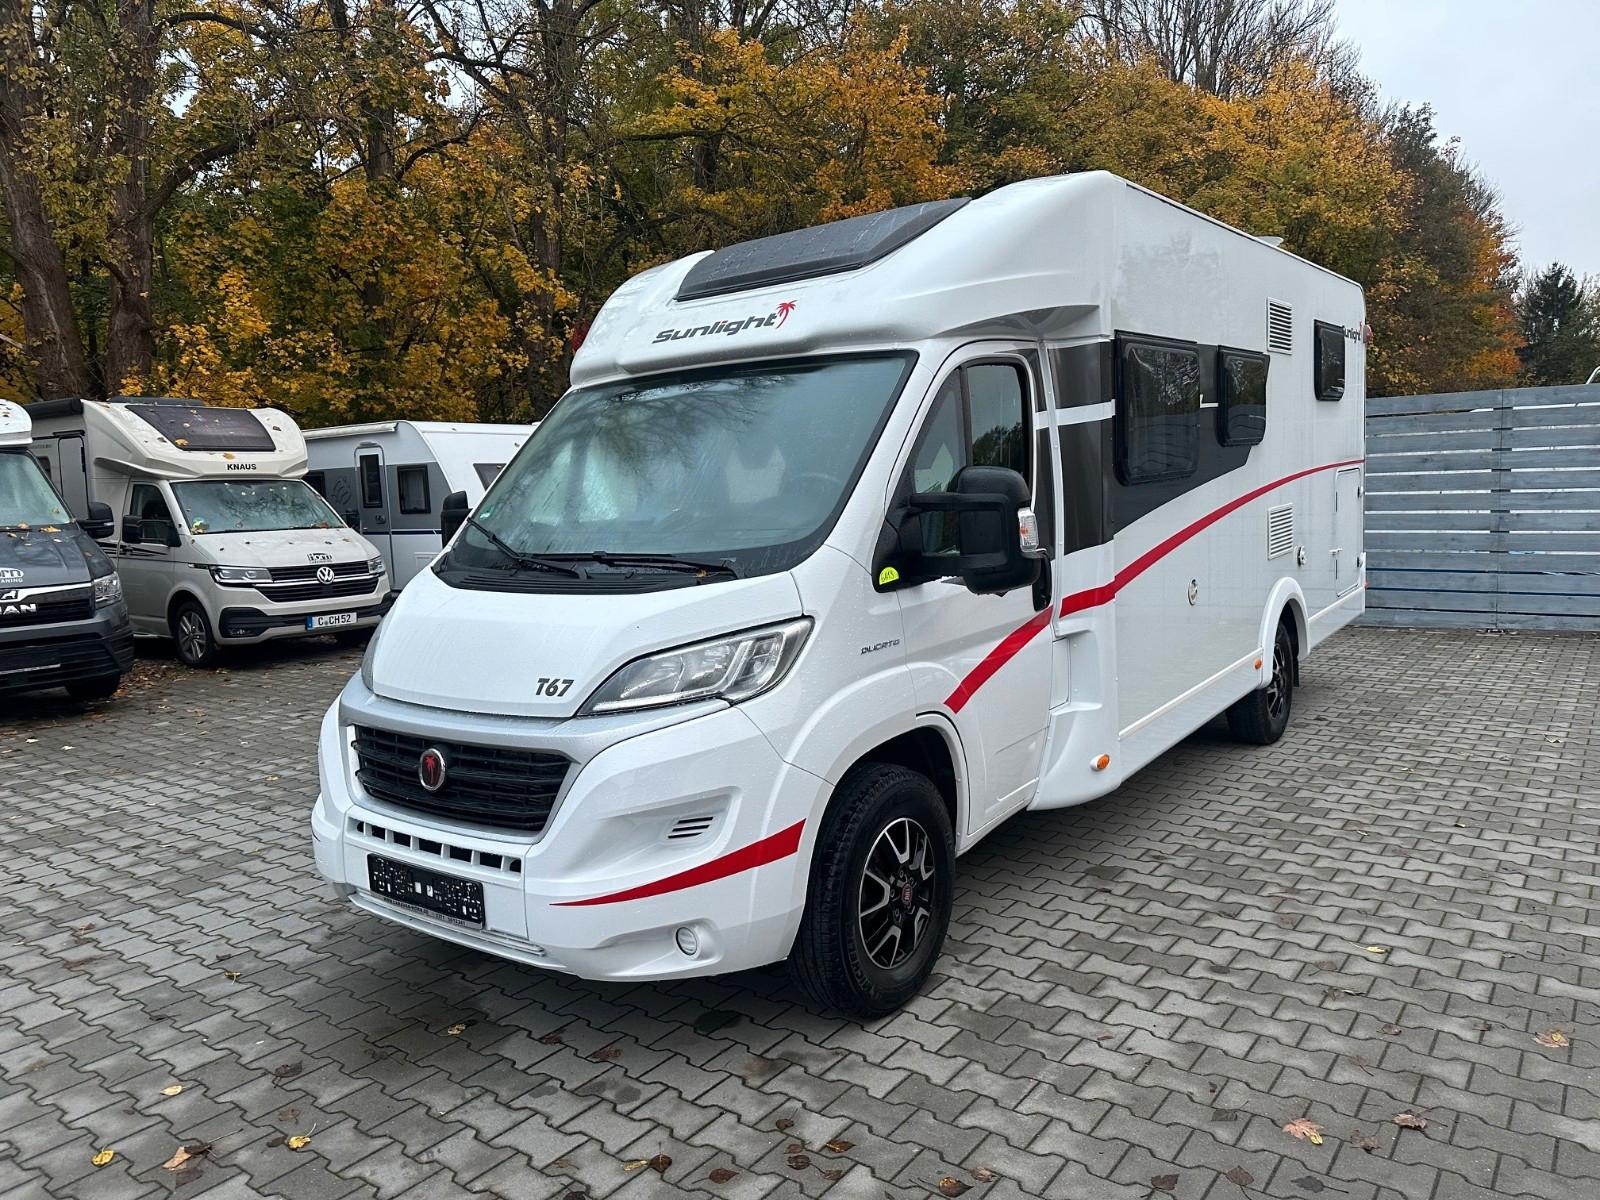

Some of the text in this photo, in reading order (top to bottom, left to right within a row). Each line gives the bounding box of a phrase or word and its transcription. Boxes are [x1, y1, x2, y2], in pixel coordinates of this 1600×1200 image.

[652, 313, 777, 344] Sunlight
[227, 463, 257, 471] KNAUS
[861, 639, 900, 655] DUCATO
[536, 678, 574, 697] T67
